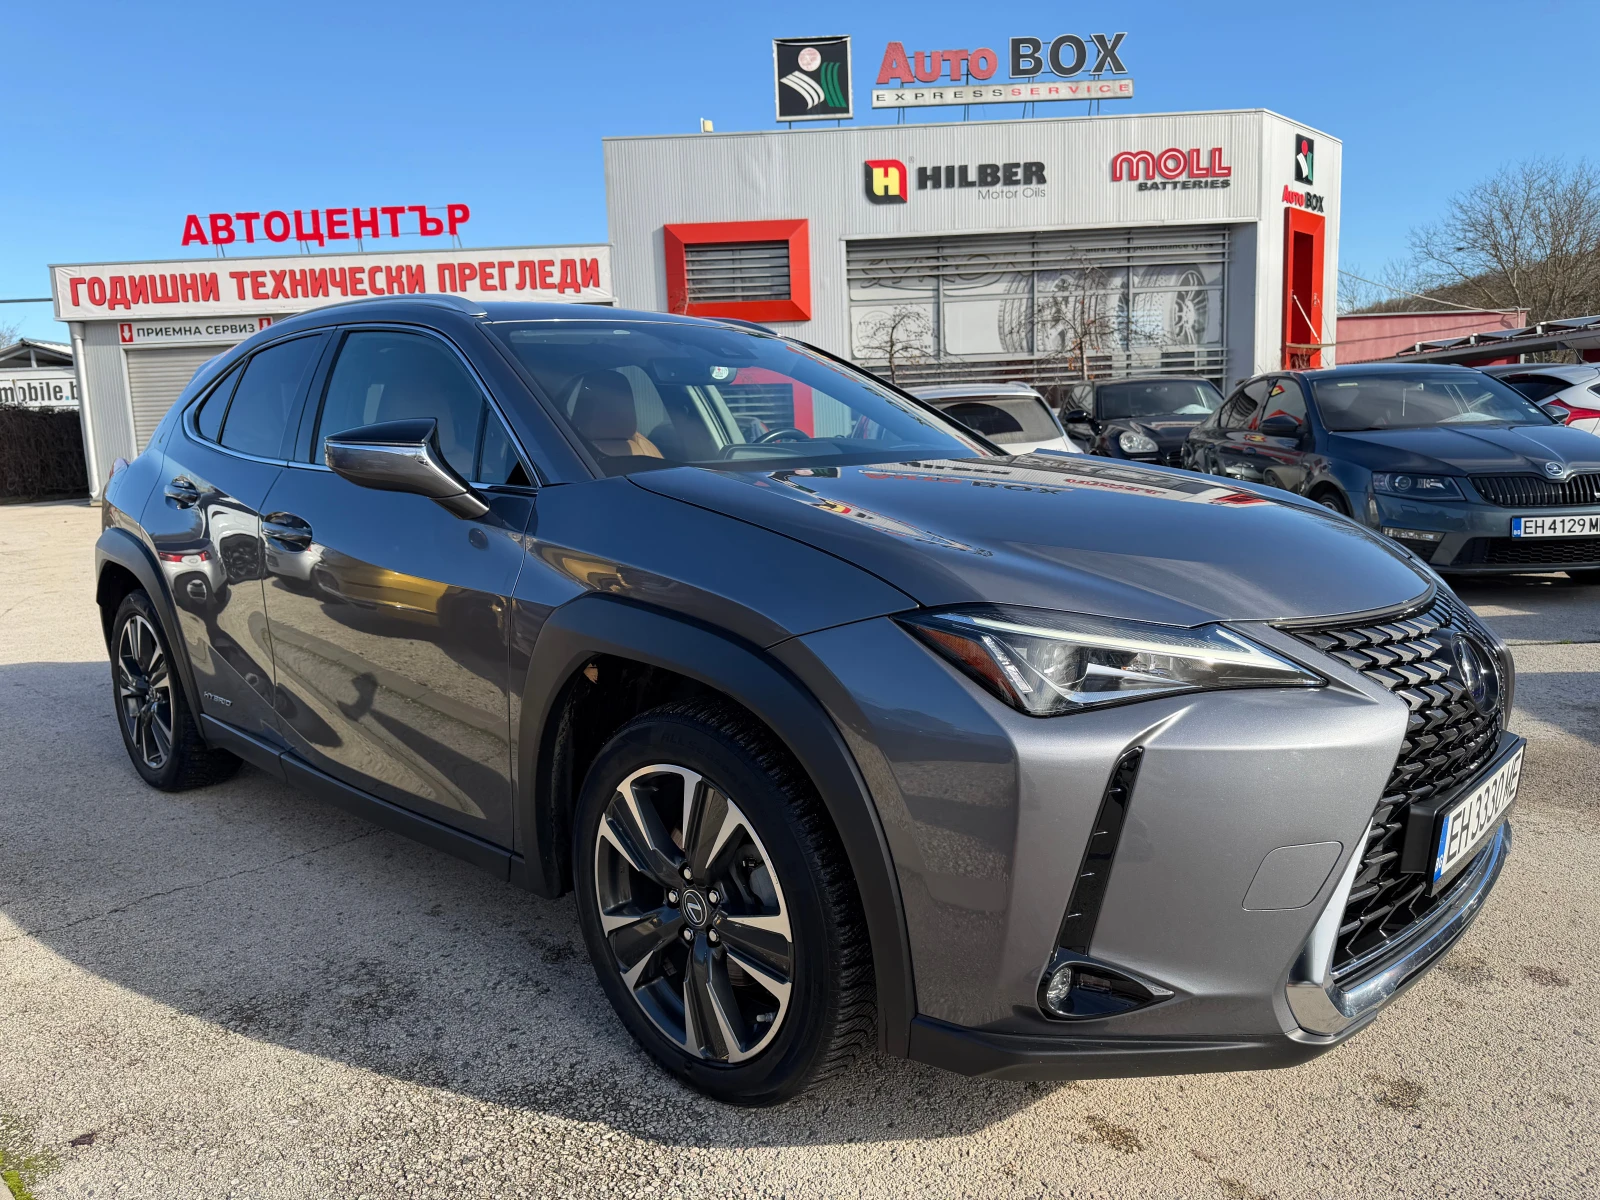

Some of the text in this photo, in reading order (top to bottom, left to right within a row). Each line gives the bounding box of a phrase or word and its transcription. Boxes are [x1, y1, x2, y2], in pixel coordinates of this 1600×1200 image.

[1009, 32, 1128, 78] BOX
[876, 84, 1129, 102] EXPRESS SERVICE
[1112, 147, 1231, 182] MOLL
[917, 162, 1047, 190] HILBER
[1138, 179, 1231, 191] BATTERIES
[977, 187, 1046, 200] Motor Oils
[1304, 191, 1324, 213] BOX
[181, 203, 470, 247] АВТОЦЕНТЪР
[69, 258, 601, 310] ГОДИШНИ ТЕХНИЧЕСКИ ПРЕГЛЕДИ
[137, 323, 255, 338] ПРИЕМНА СЕРВИЗ
[1524, 520, 1545, 535] EH
[1548, 518, 1586, 534] 4129
[1589, 517, 1600, 533] M
[203, 691, 232, 707] HYBRID
[1446, 801, 1473, 864] EH
[1471, 771, 1505, 840] 3330
